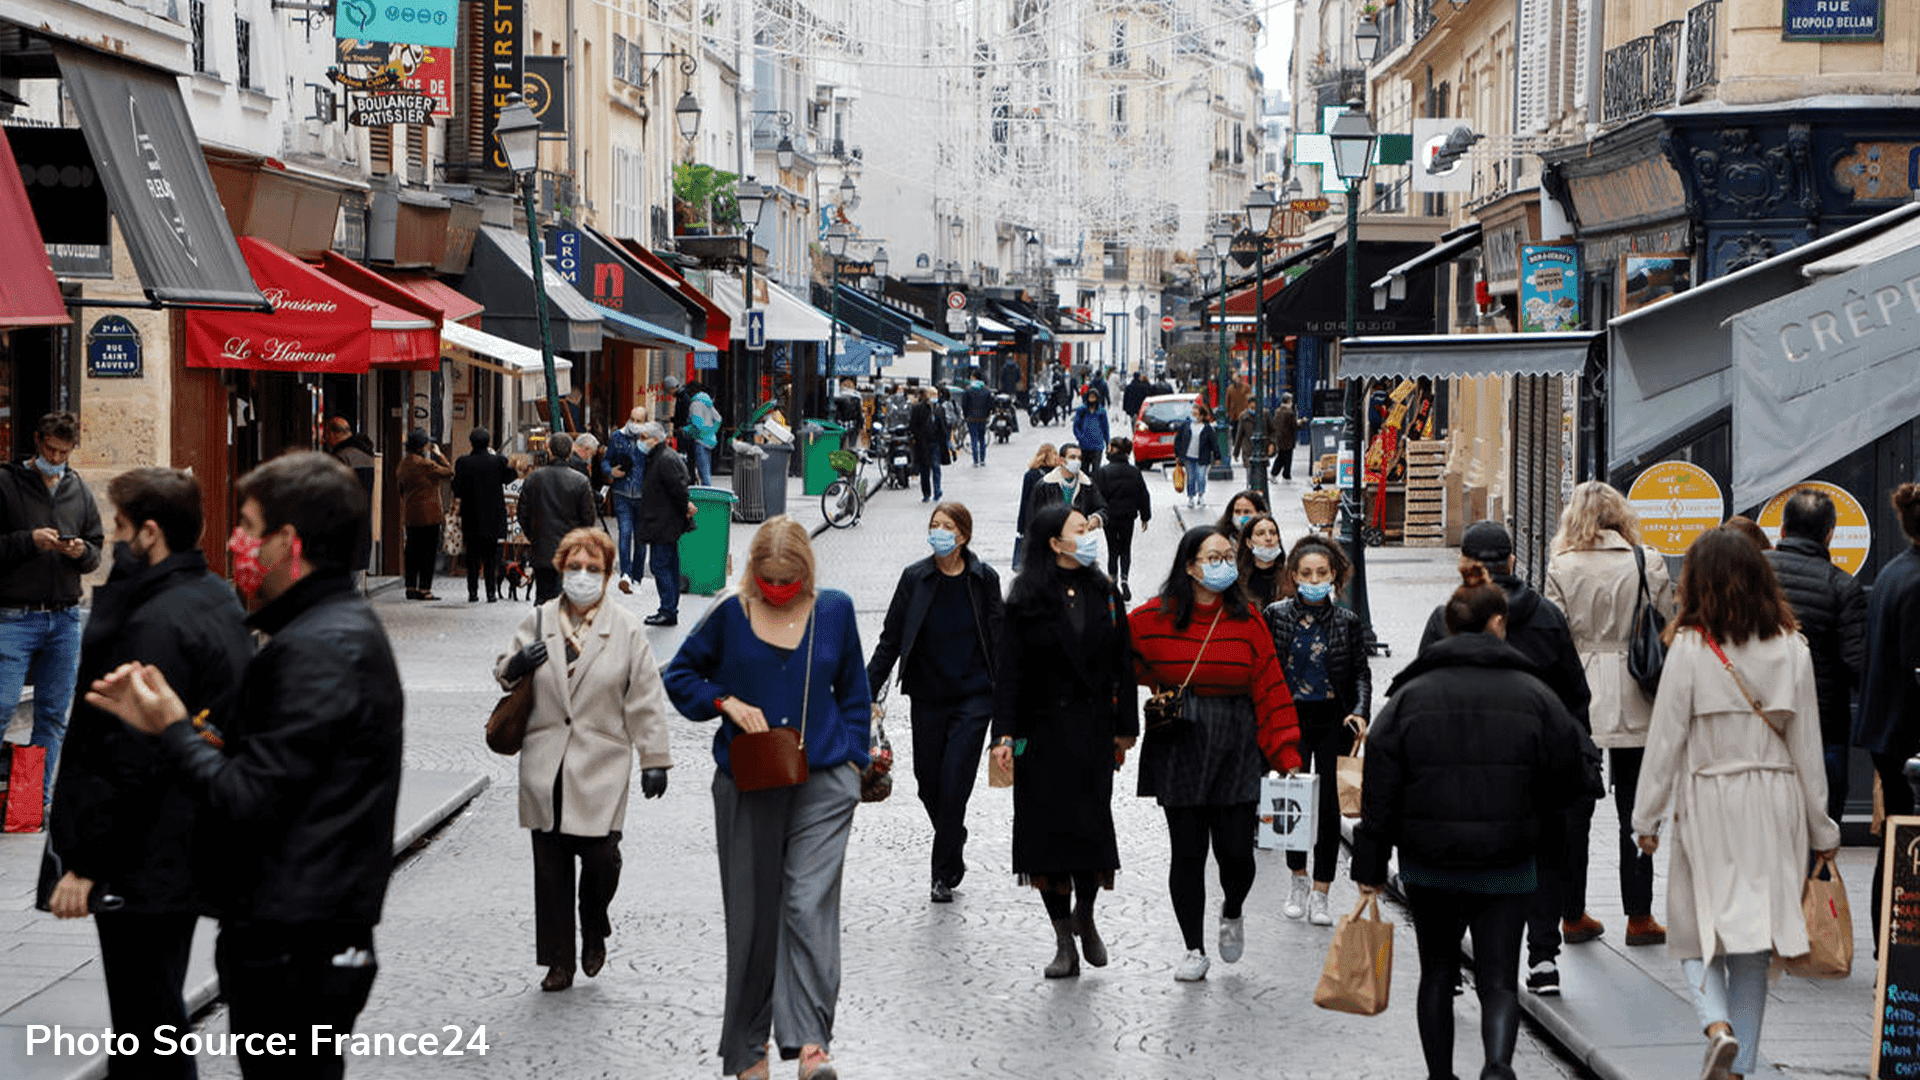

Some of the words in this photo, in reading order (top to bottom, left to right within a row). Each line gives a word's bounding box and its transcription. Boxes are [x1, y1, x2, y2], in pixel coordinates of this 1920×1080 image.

[1817, 0, 1849, 12] RUE
[1792, 16, 1835, 29] LEOPOLD
[1836, 15, 1874, 28] BELLAN
[431, 79, 446, 94] DE
[357, 94, 432, 112] BOULANGER
[360, 109, 425, 125] PATISSIER
[561, 233, 577, 282] GROM
[261, 287, 337, 312] Brasserie
[106, 344, 122, 352] RUE
[220, 336, 252, 360] Le
[261, 337, 337, 362] Havane
[102, 352, 127, 360] SAINT
[95, 361, 135, 369] SAUVEUR
